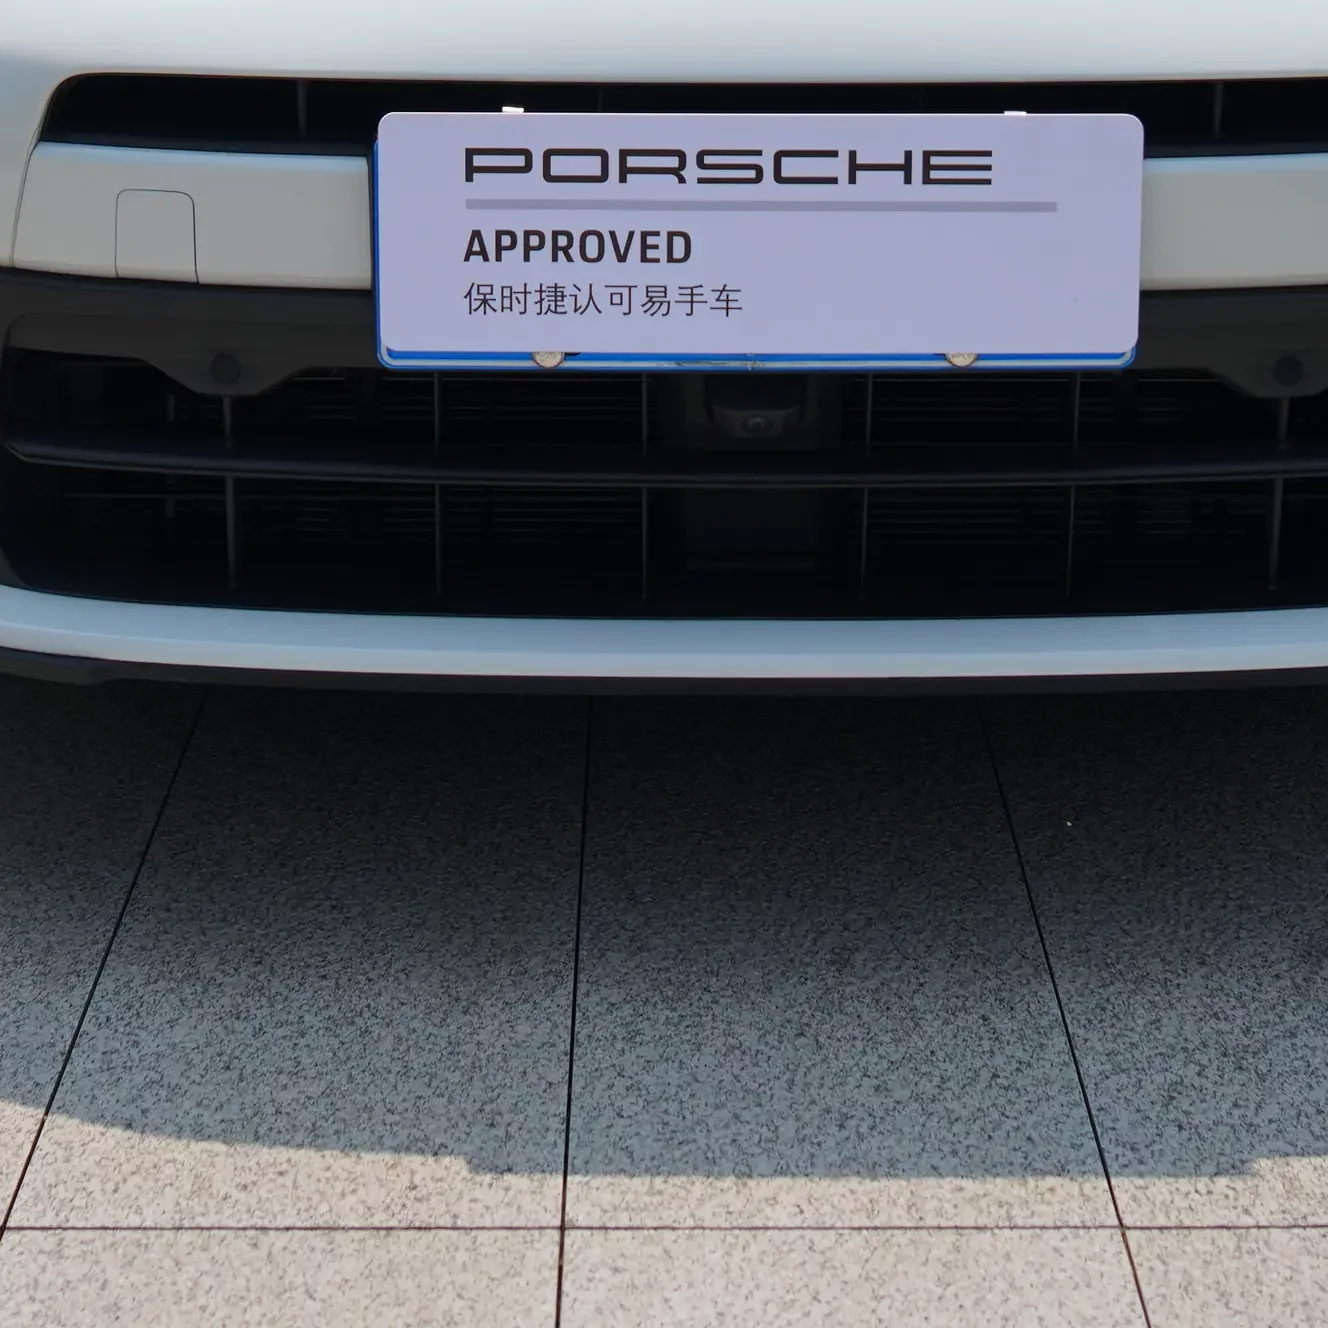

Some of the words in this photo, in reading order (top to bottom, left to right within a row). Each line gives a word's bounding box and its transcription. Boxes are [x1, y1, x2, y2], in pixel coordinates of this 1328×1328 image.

[464, 147, 993, 186] PORSCHE
[463, 229, 692, 264] APPROVED
[463, 282, 743, 318] 保时捷认可易手车
